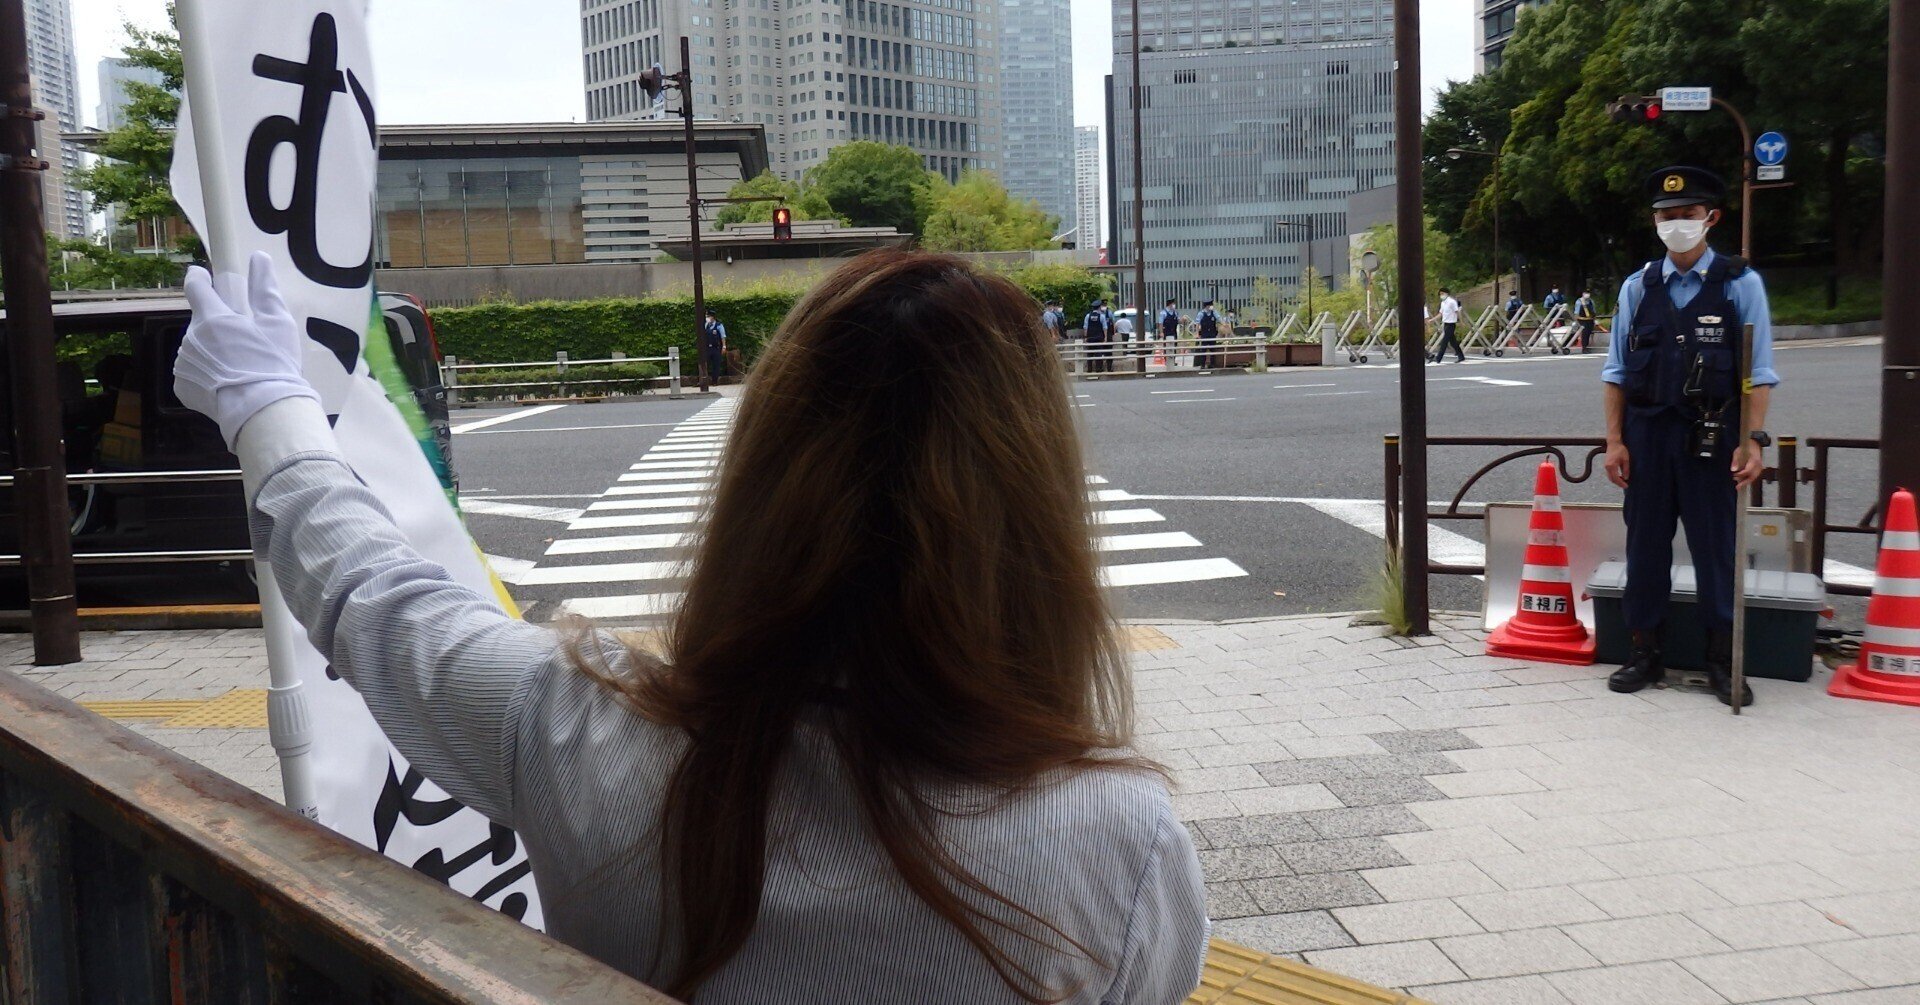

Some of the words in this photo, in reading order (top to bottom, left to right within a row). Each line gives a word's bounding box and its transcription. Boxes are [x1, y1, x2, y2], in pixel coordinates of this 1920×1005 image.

[244, 12, 374, 289] む
[1523, 595, 1566, 612] 警視庁
